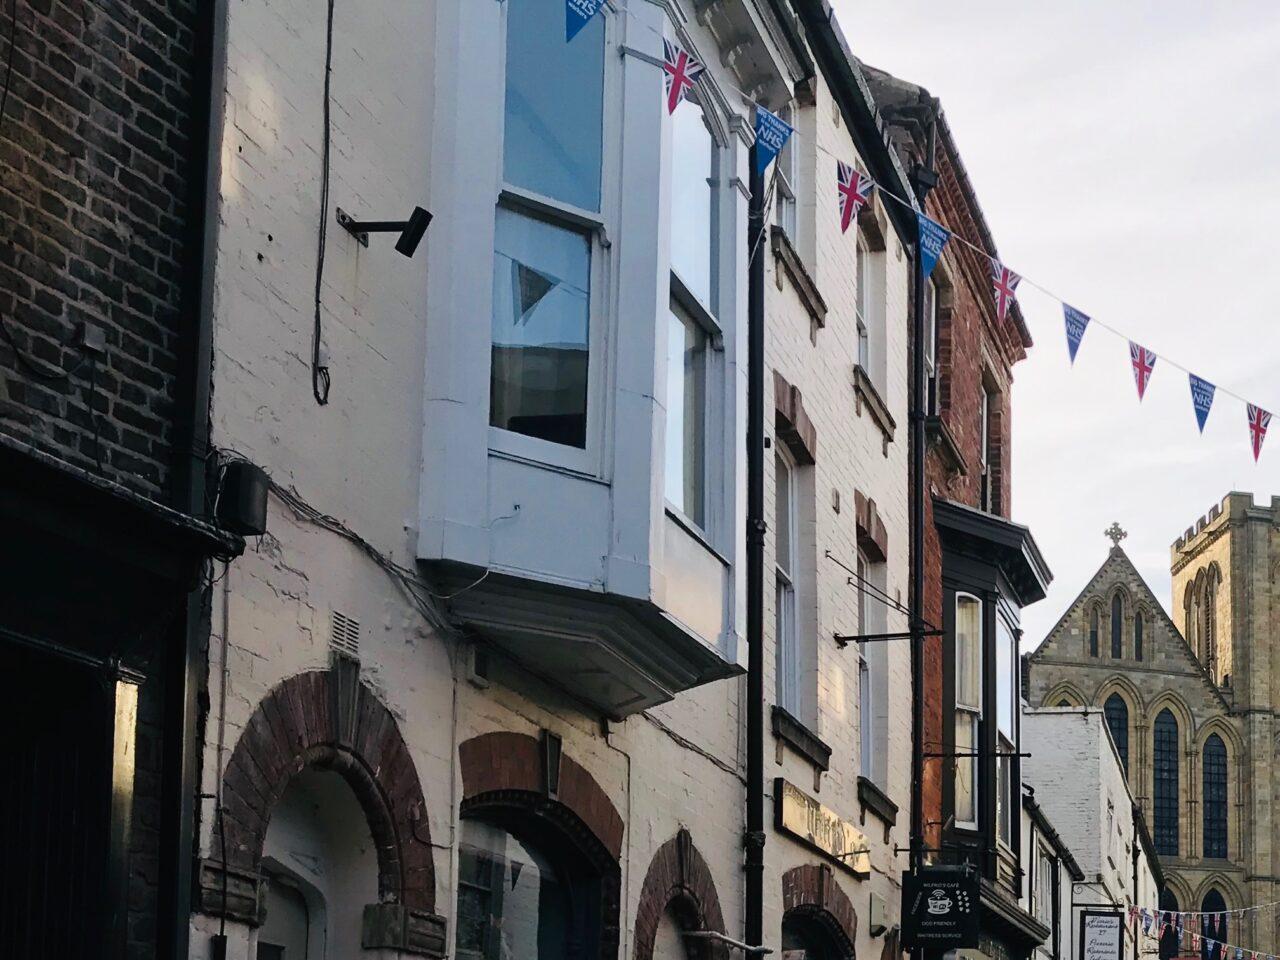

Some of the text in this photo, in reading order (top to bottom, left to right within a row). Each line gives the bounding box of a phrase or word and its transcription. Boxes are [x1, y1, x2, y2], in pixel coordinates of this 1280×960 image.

[757, 125, 783, 149] NHS
[921, 233, 942, 255] NHS
[1194, 391, 1212, 408] NHS
